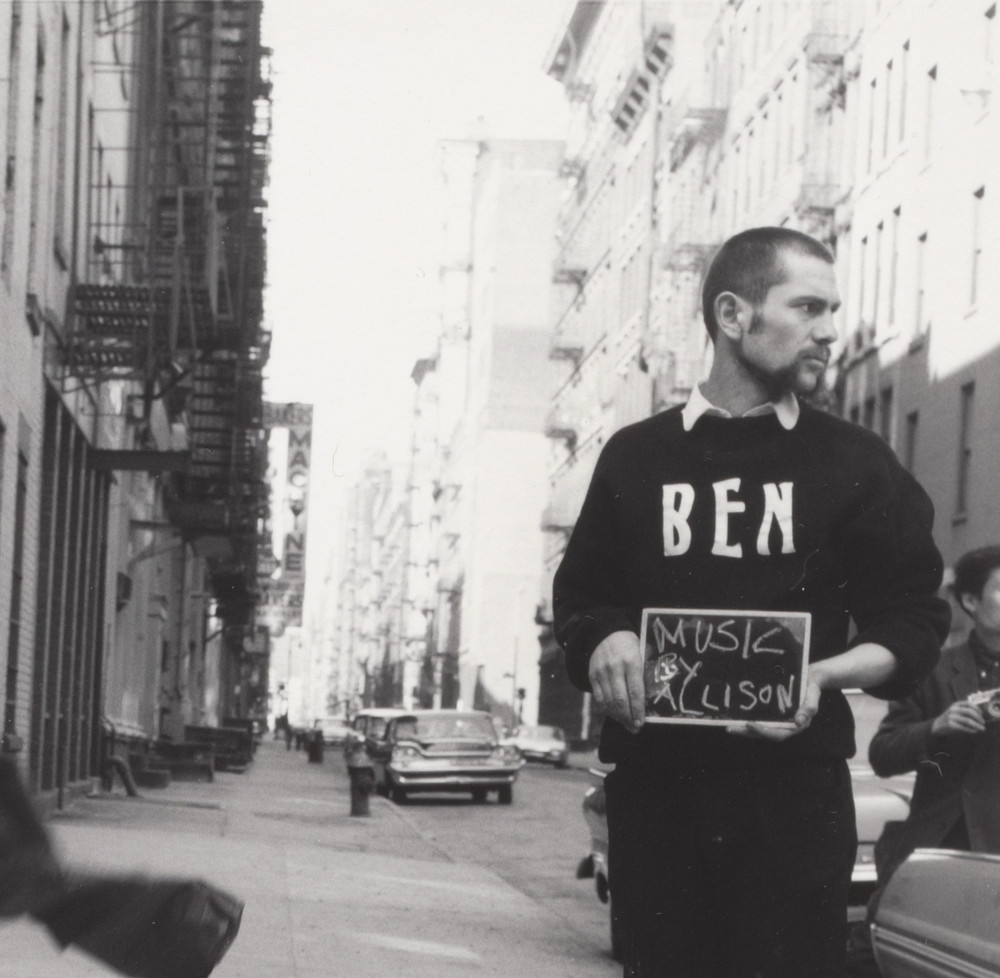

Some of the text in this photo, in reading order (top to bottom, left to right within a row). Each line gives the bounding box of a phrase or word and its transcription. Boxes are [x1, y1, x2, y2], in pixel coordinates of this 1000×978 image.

[662, 477, 797, 559] BEN
[653, 616, 785, 659] MUSIC
[655, 653, 703, 684] BY
[654, 674, 796, 715] ALLISON
